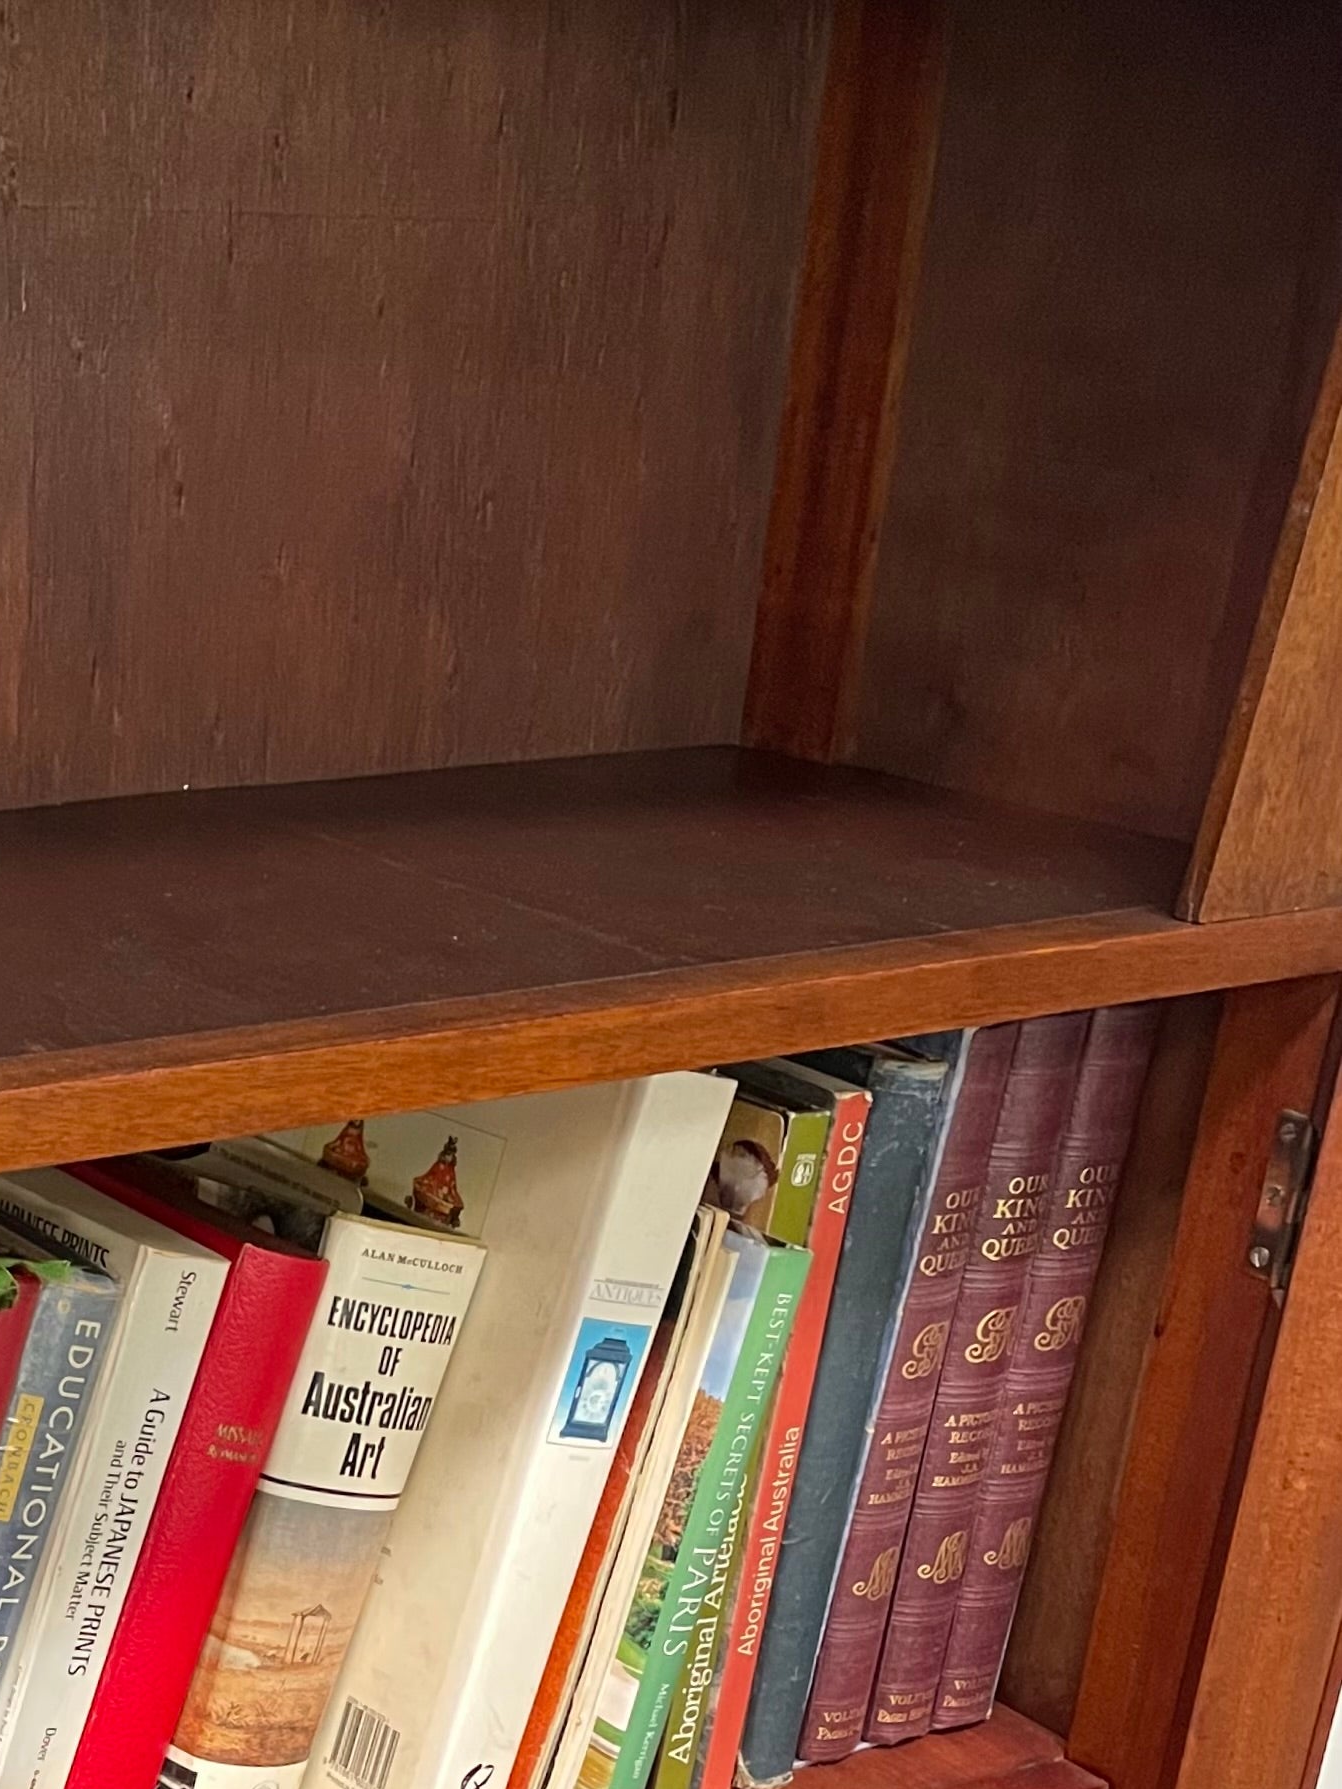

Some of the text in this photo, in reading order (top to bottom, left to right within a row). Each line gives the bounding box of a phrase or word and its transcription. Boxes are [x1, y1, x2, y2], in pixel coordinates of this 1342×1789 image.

[828, 1121, 865, 1216] AGDC
[361, 1247, 463, 1275] ALAN McCULLOCH
[164, 1270, 197, 1333] Stewart
[327, 1296, 458, 1346] ENCYCLOPEDIA
[377, 1345, 404, 1377] OF
[301, 1371, 435, 1432] Australian
[944, 1415, 958, 1428] A
[340, 1432, 386, 1480] Art
[663, 1293, 793, 1657] BEST-KEPT SECRETS OF PARIS
[64, 1438, 128, 1622] and Their Subject Matter
[67, 1387, 171, 1677] A Guide to JAPANESE PRINTS
[737, 1426, 800, 1657] Aboriginal Australia
[667, 1616, 718, 1766] Aboriginal
[37, 1727, 58, 1761] Dover
